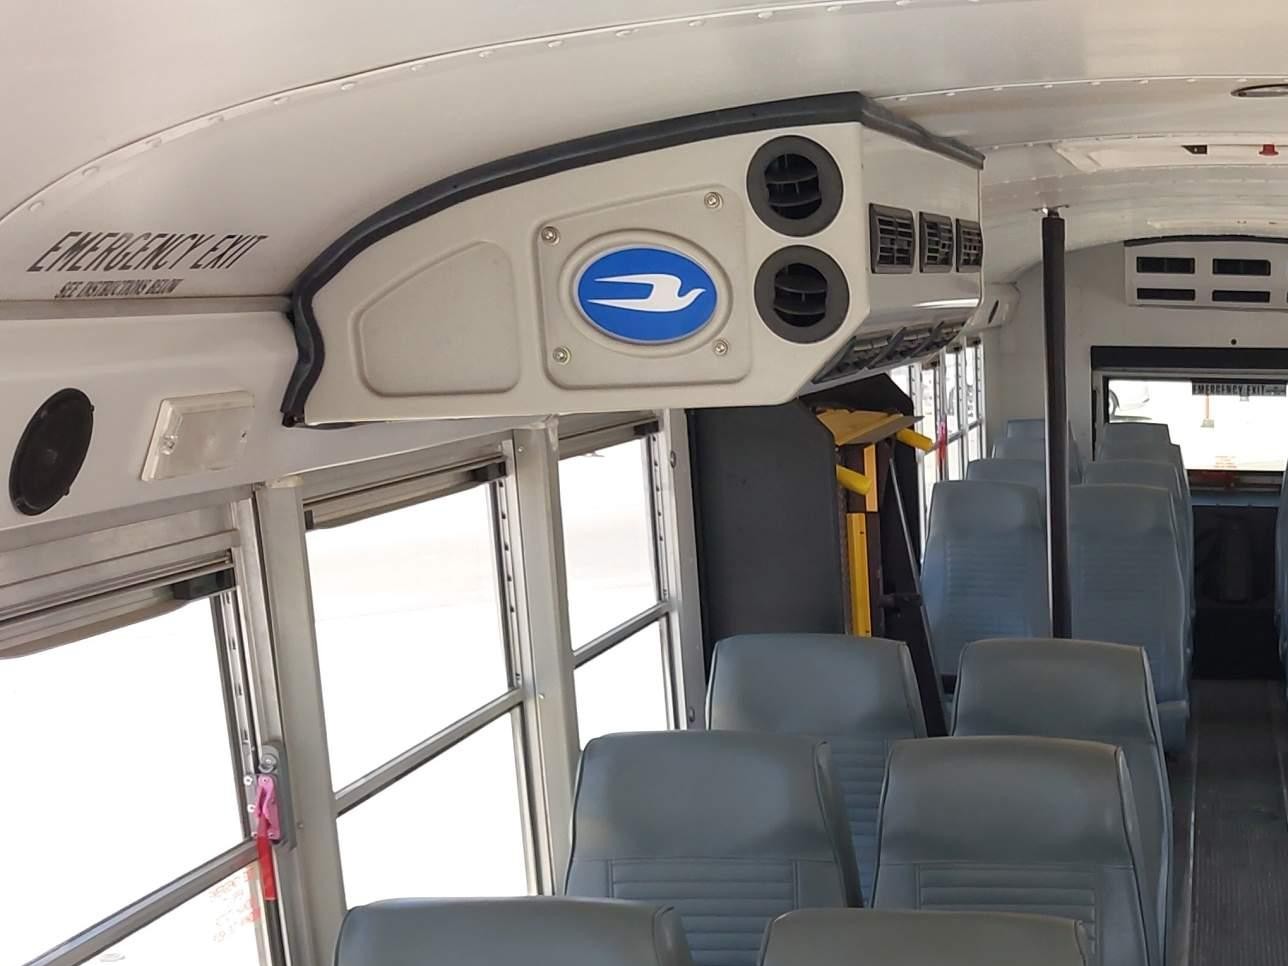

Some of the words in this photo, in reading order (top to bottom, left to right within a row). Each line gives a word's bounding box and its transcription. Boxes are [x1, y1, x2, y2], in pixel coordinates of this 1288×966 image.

[26, 231, 214, 272] EMERGENCY
[189, 234, 268, 270] EXIT
[1192, 383, 1243, 395] EMERGENCY
[1246, 384, 1264, 396] EXIT
